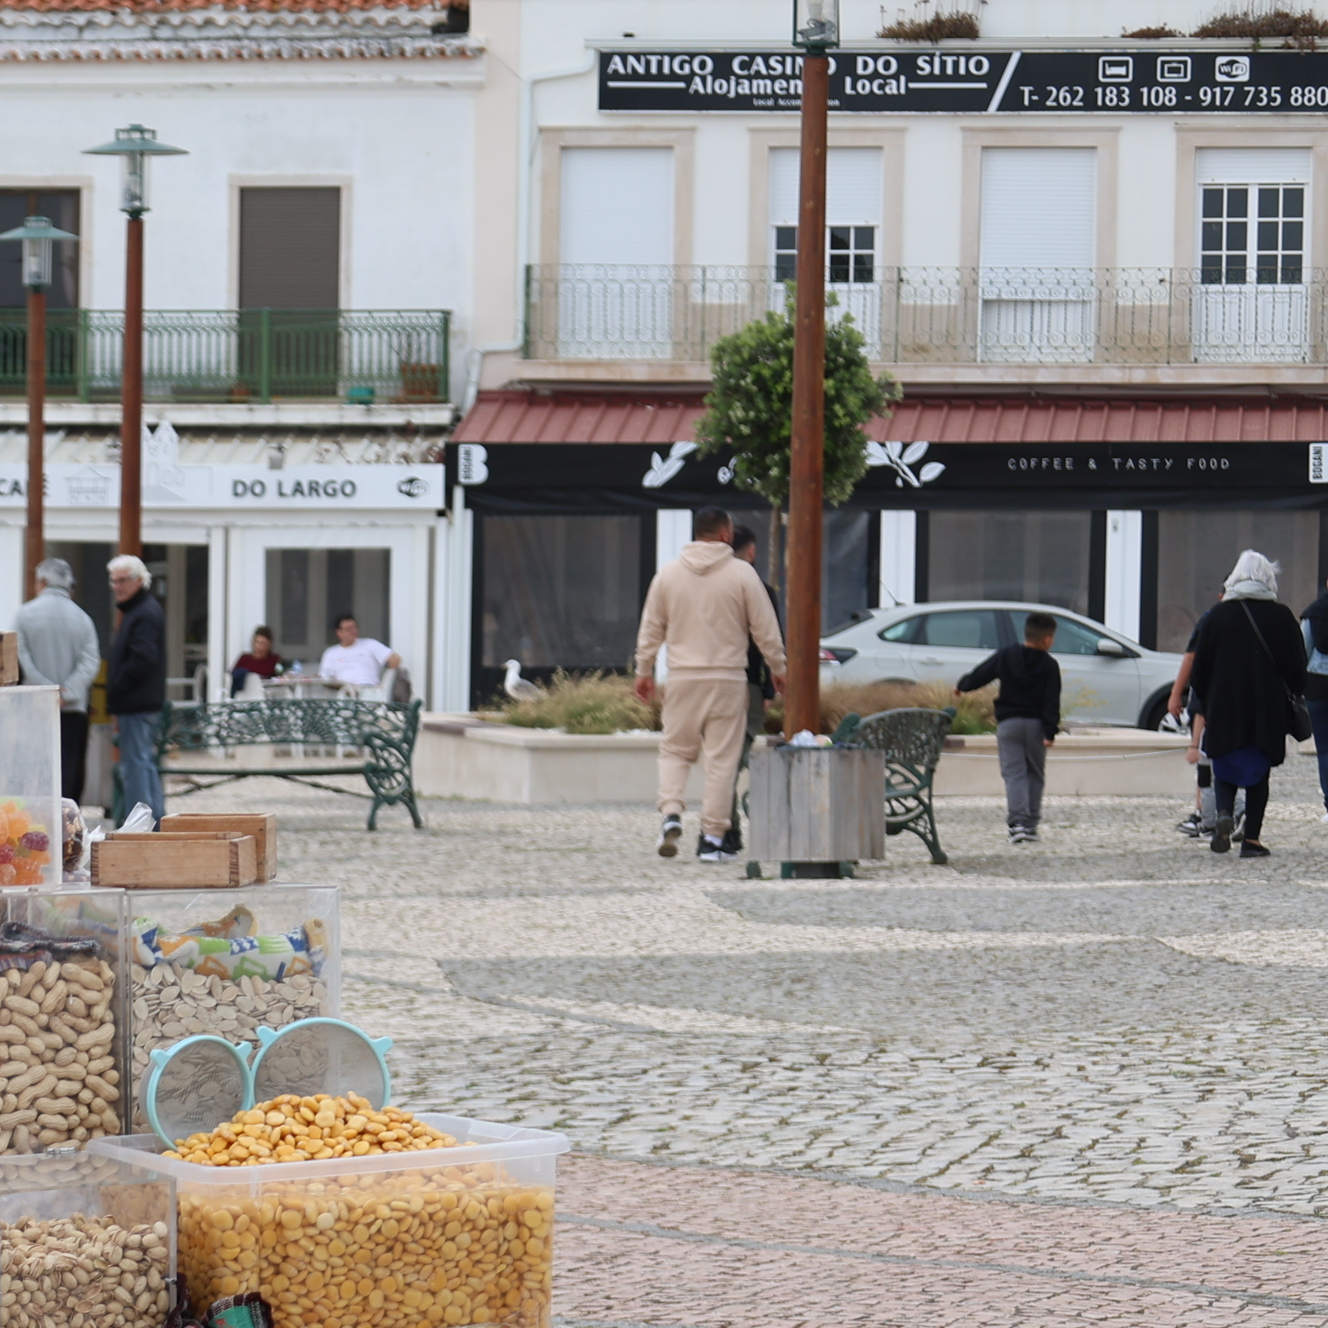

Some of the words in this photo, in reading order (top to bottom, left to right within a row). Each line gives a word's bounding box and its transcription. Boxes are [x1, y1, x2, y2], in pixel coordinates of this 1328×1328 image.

[607, 54, 715, 76] ANTIGO
[856, 55, 898, 76] DO
[916, 51, 991, 76] SÍTIO
[689, 75, 803, 98] Alojamen
[845, 75, 907, 95] Local
[1046, 86, 1085, 107] 262
[1095, 86, 1131, 107] 183
[1140, 86, 1177, 107] 108
[1200, 86, 1234, 107] 917
[1244, 86, 1282, 107] 735
[1290, 86, 1328, 107] 880
[1008, 457, 1075, 471] COFFEE
[1088, 457, 1098, 471] &
[1112, 457, 1175, 471] TASTY
[1187, 457, 1231, 471] FOOD
[232, 479, 266, 498] DO
[278, 479, 357, 498] LARGO
